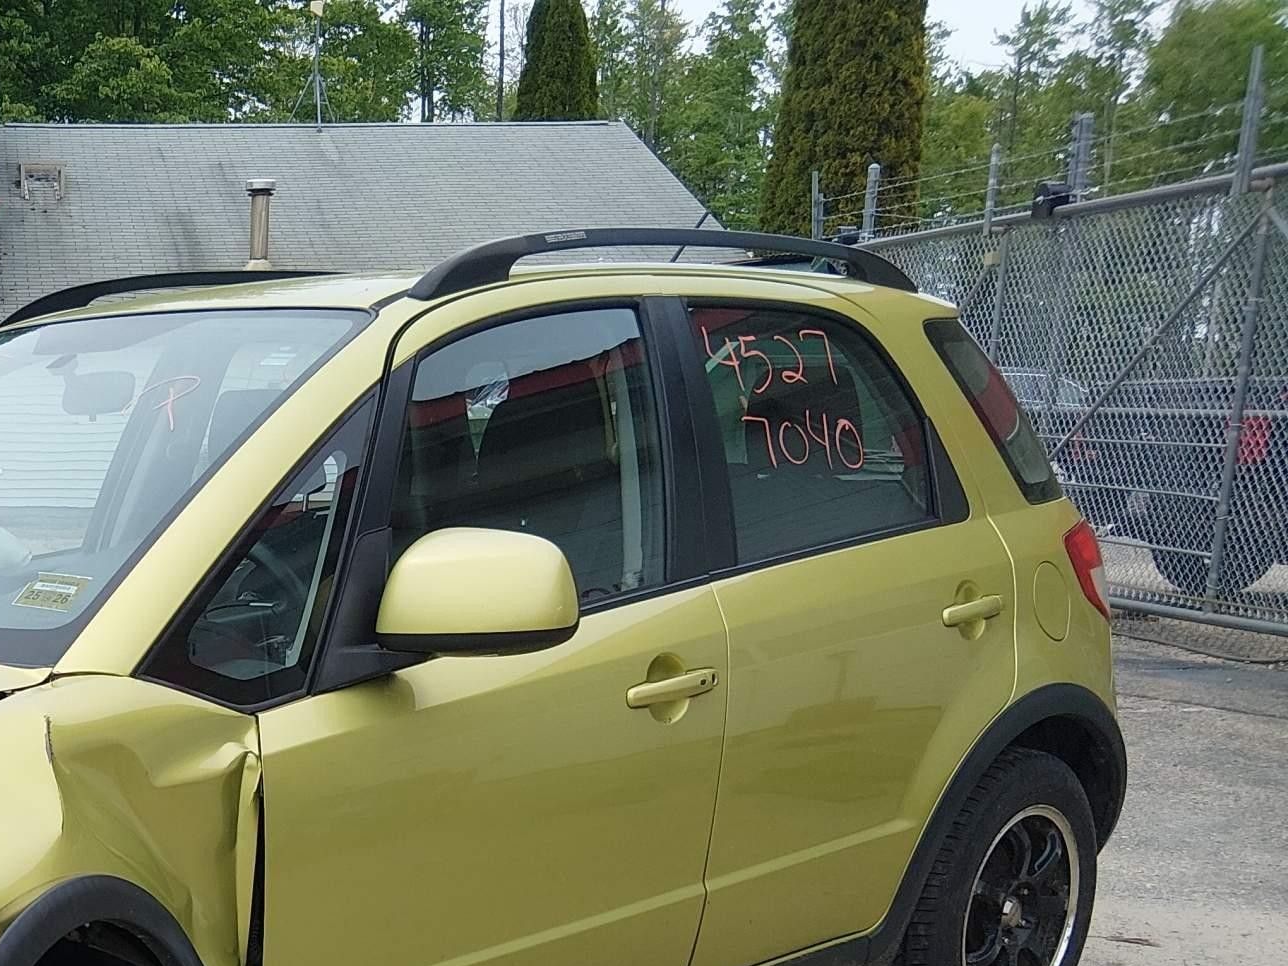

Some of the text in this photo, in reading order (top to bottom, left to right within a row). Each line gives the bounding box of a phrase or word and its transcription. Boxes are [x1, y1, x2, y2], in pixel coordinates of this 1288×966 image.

[700, 326, 838, 394] 4527
[741, 409, 864, 470] 7040
[52, 593, 72, 605] 26
